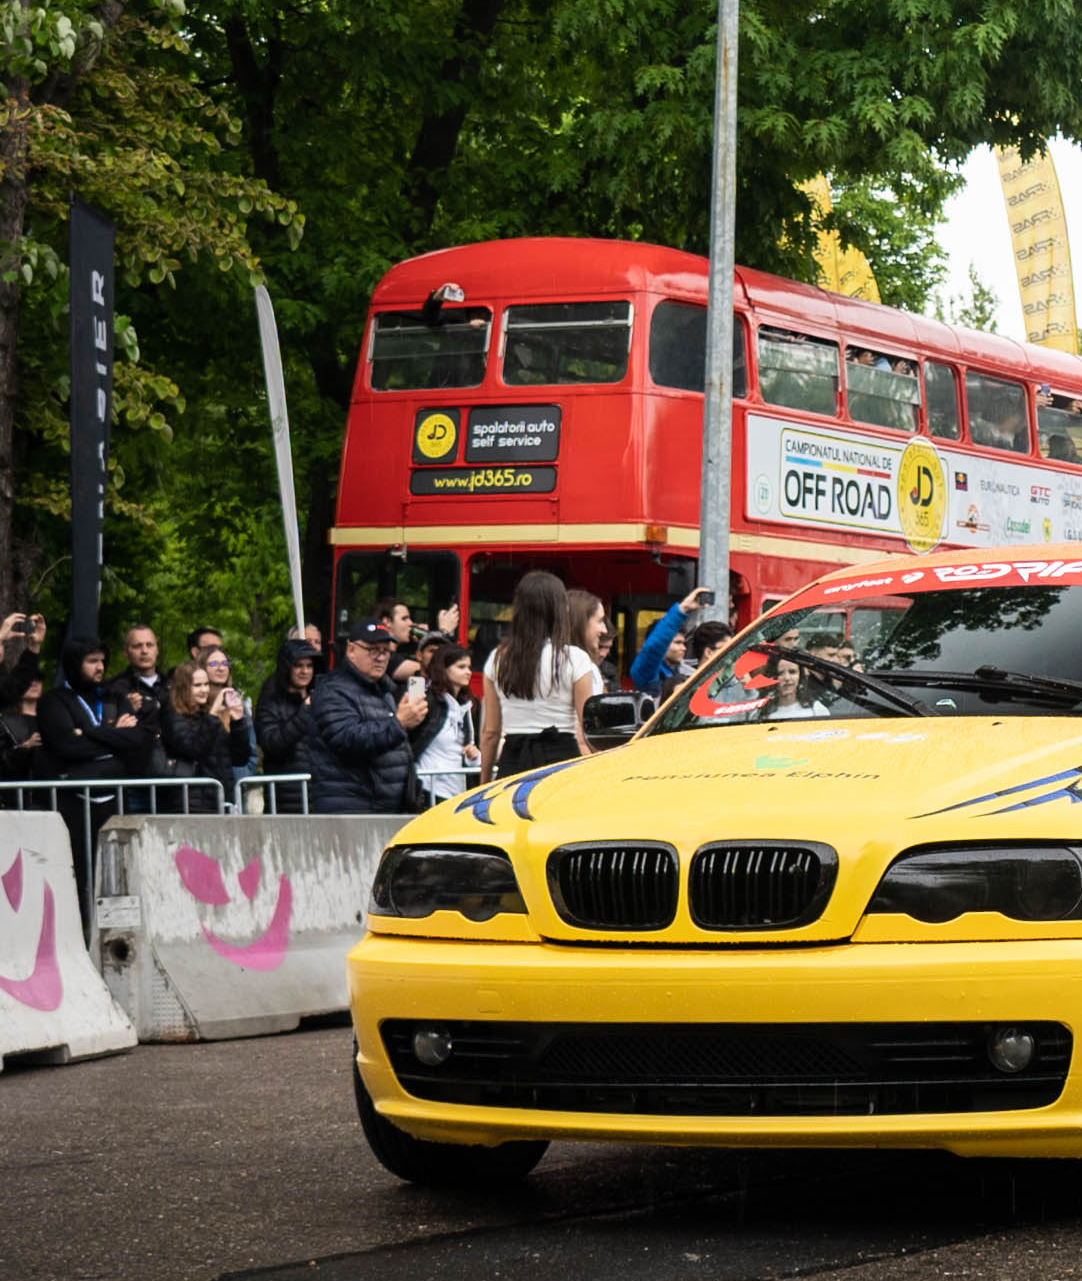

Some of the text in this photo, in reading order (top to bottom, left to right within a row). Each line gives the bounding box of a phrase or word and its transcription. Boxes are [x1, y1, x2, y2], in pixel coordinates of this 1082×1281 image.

[472, 435, 541, 448] self service
[473, 419, 555, 437] spalatorii auto
[785, 439, 892, 471] CAMPIONATUL NATIONAL DE
[434, 468, 532, 493] www.jd365.ro
[910, 465, 933, 507] JD
[785, 469, 892, 521] OFF ROAD
